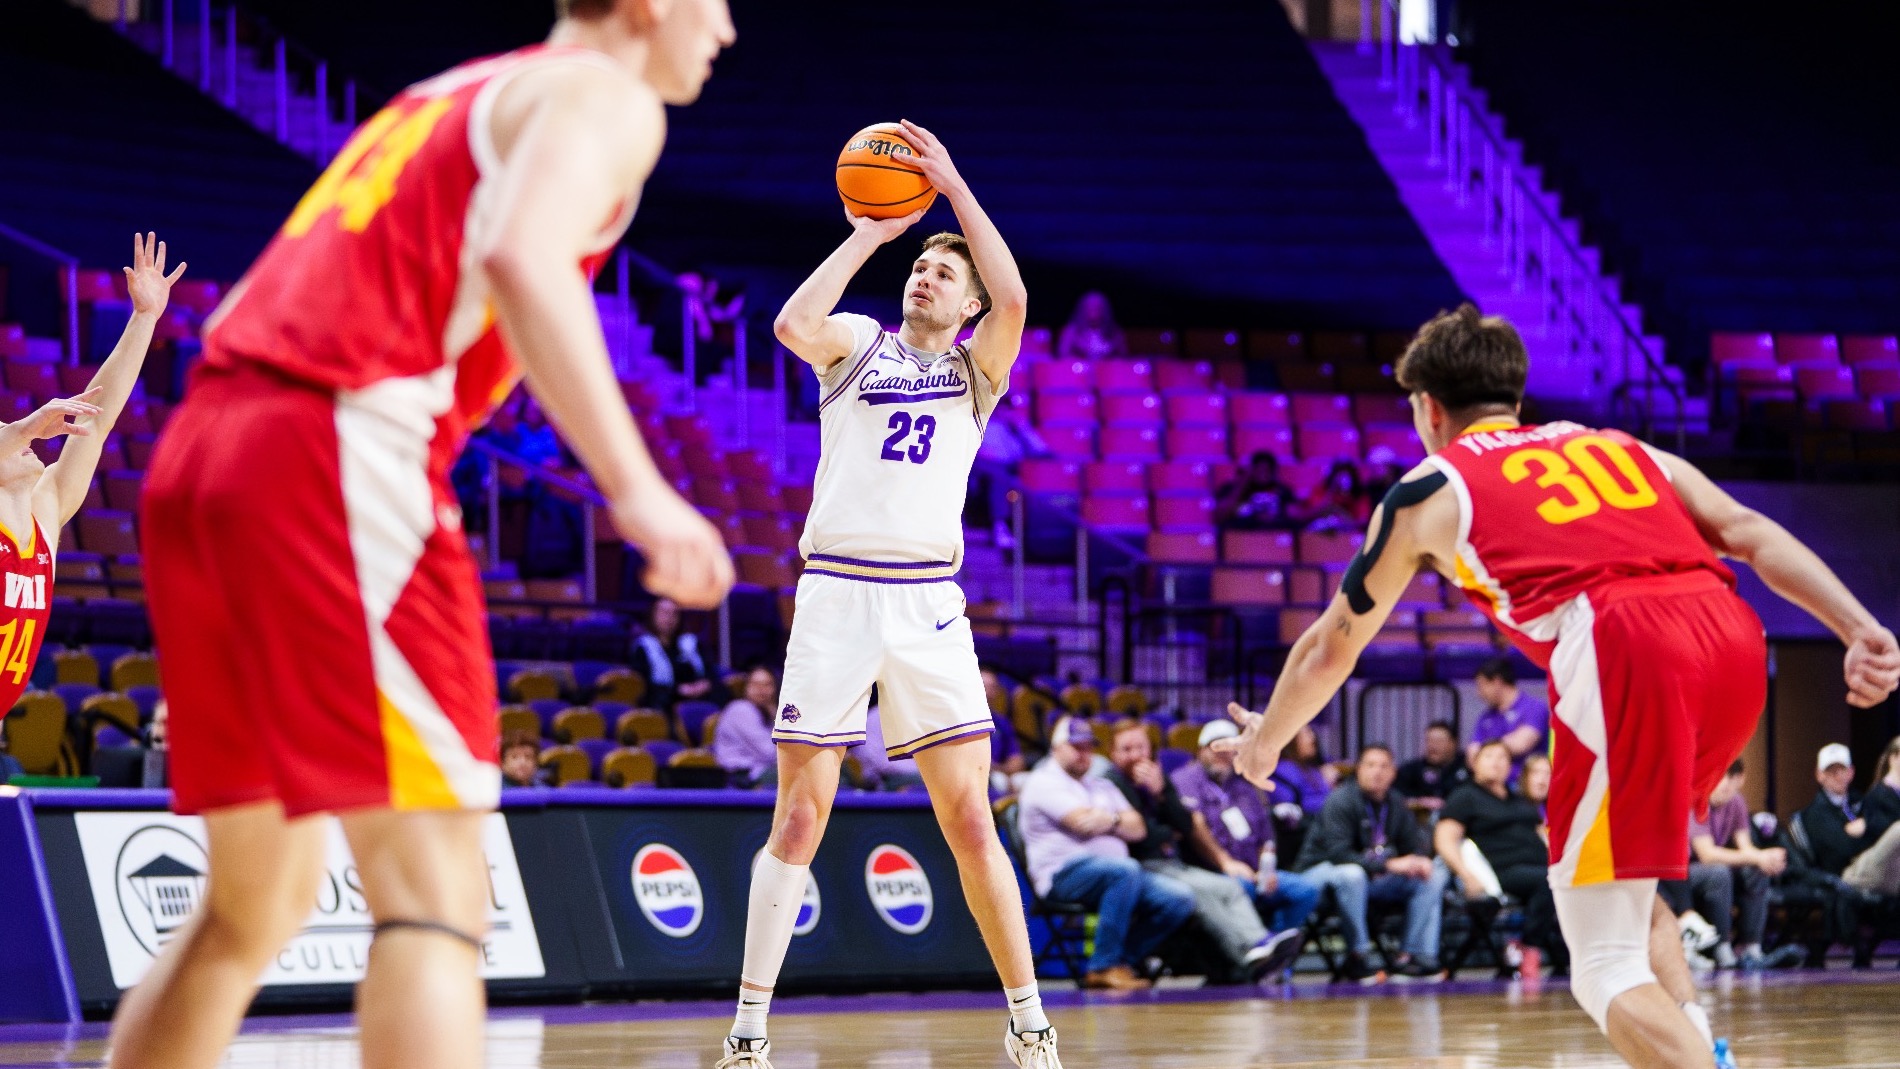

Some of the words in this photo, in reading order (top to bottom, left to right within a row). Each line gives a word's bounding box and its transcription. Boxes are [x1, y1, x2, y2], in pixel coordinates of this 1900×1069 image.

[848, 139, 913, 158] Wilson
[860, 369, 962, 392] Catamounts
[881, 411, 936, 465] 23
[1502, 435, 1659, 525] 30
